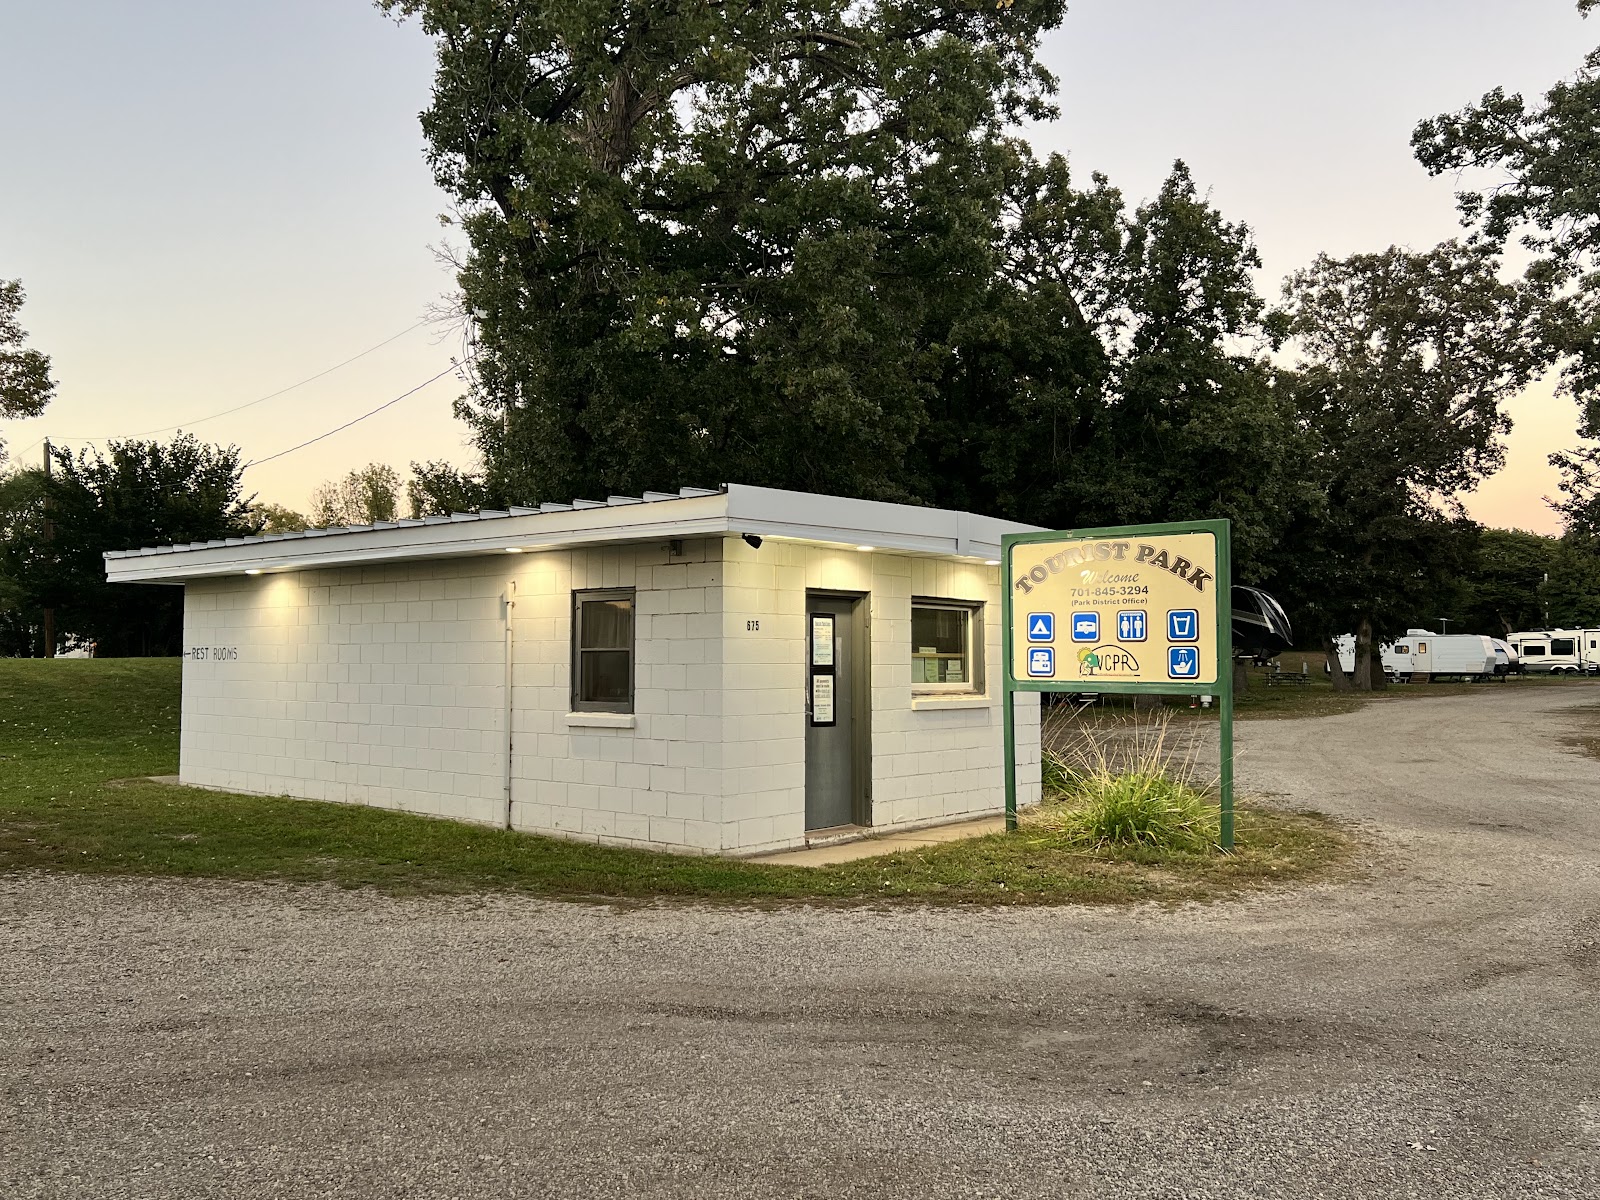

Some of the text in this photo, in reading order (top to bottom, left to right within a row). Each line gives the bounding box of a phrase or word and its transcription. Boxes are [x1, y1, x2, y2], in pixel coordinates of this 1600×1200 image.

[1015, 541, 1214, 595] TOURIST PARK
[1080, 569, 1140, 585] Welcome
[1070, 585, 1149, 597] 701-845-3294
[1071, 597, 1148, 607] (Park District Office)
[746, 620, 760, 631] 675
[191, 647, 238, 660] REST ROOMS
